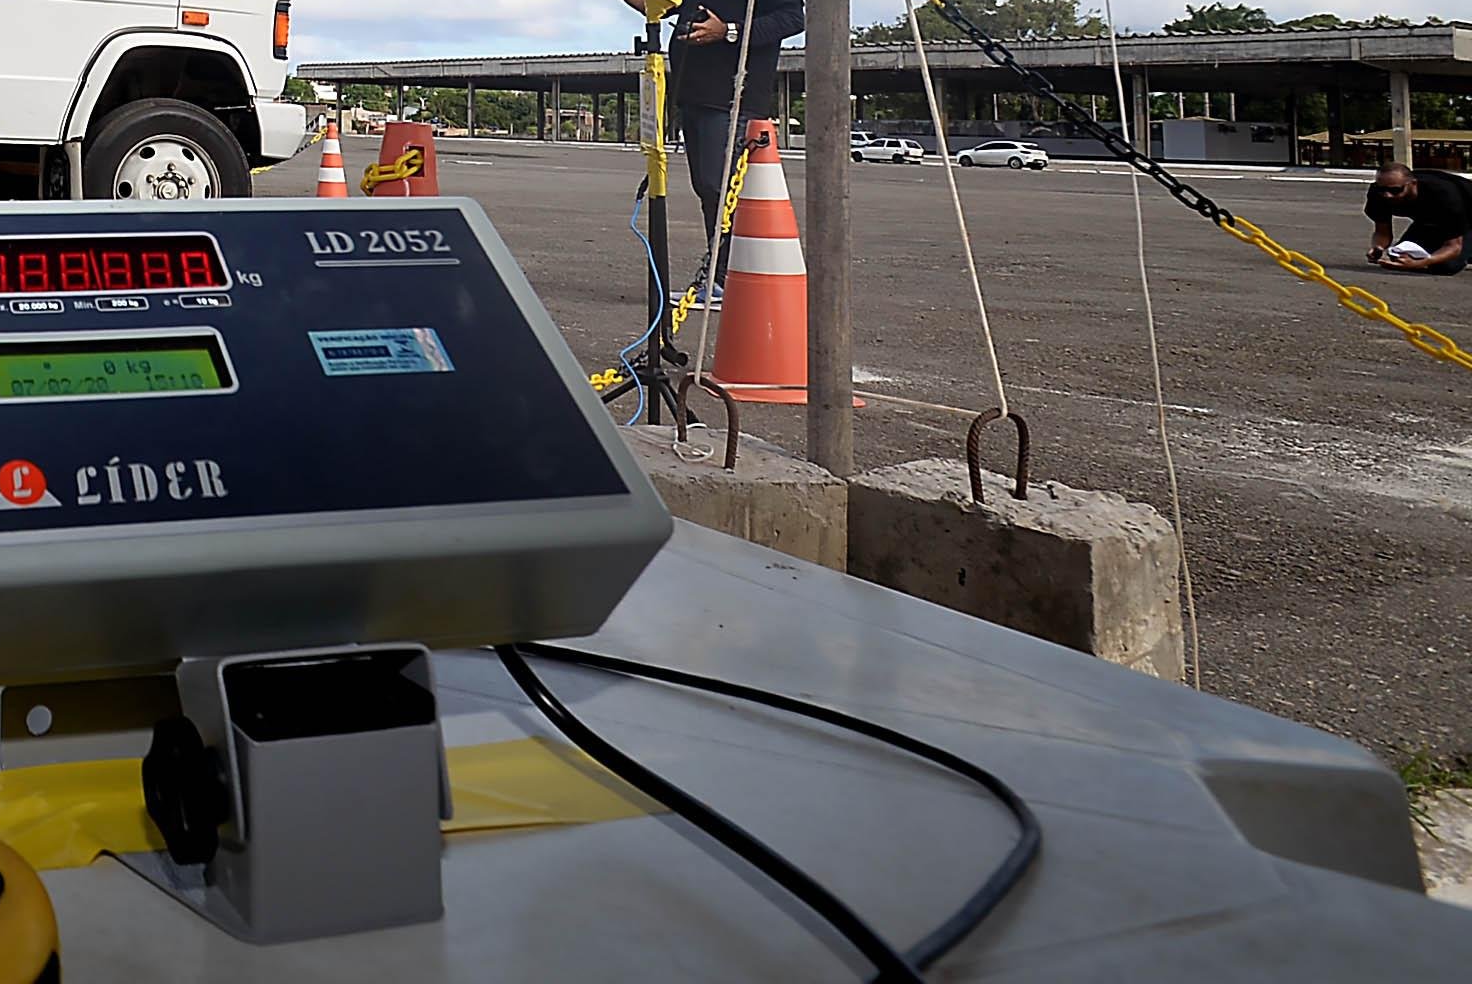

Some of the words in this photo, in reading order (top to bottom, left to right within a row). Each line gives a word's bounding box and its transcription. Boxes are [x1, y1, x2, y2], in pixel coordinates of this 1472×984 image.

[304, 231, 356, 254] LD
[359, 229, 452, 253] 2052
[235, 270, 263, 287] kg
[103, 360, 116, 375] 0
[126, 359, 152, 374] kg
[76, 456, 228, 506] LÍDER
